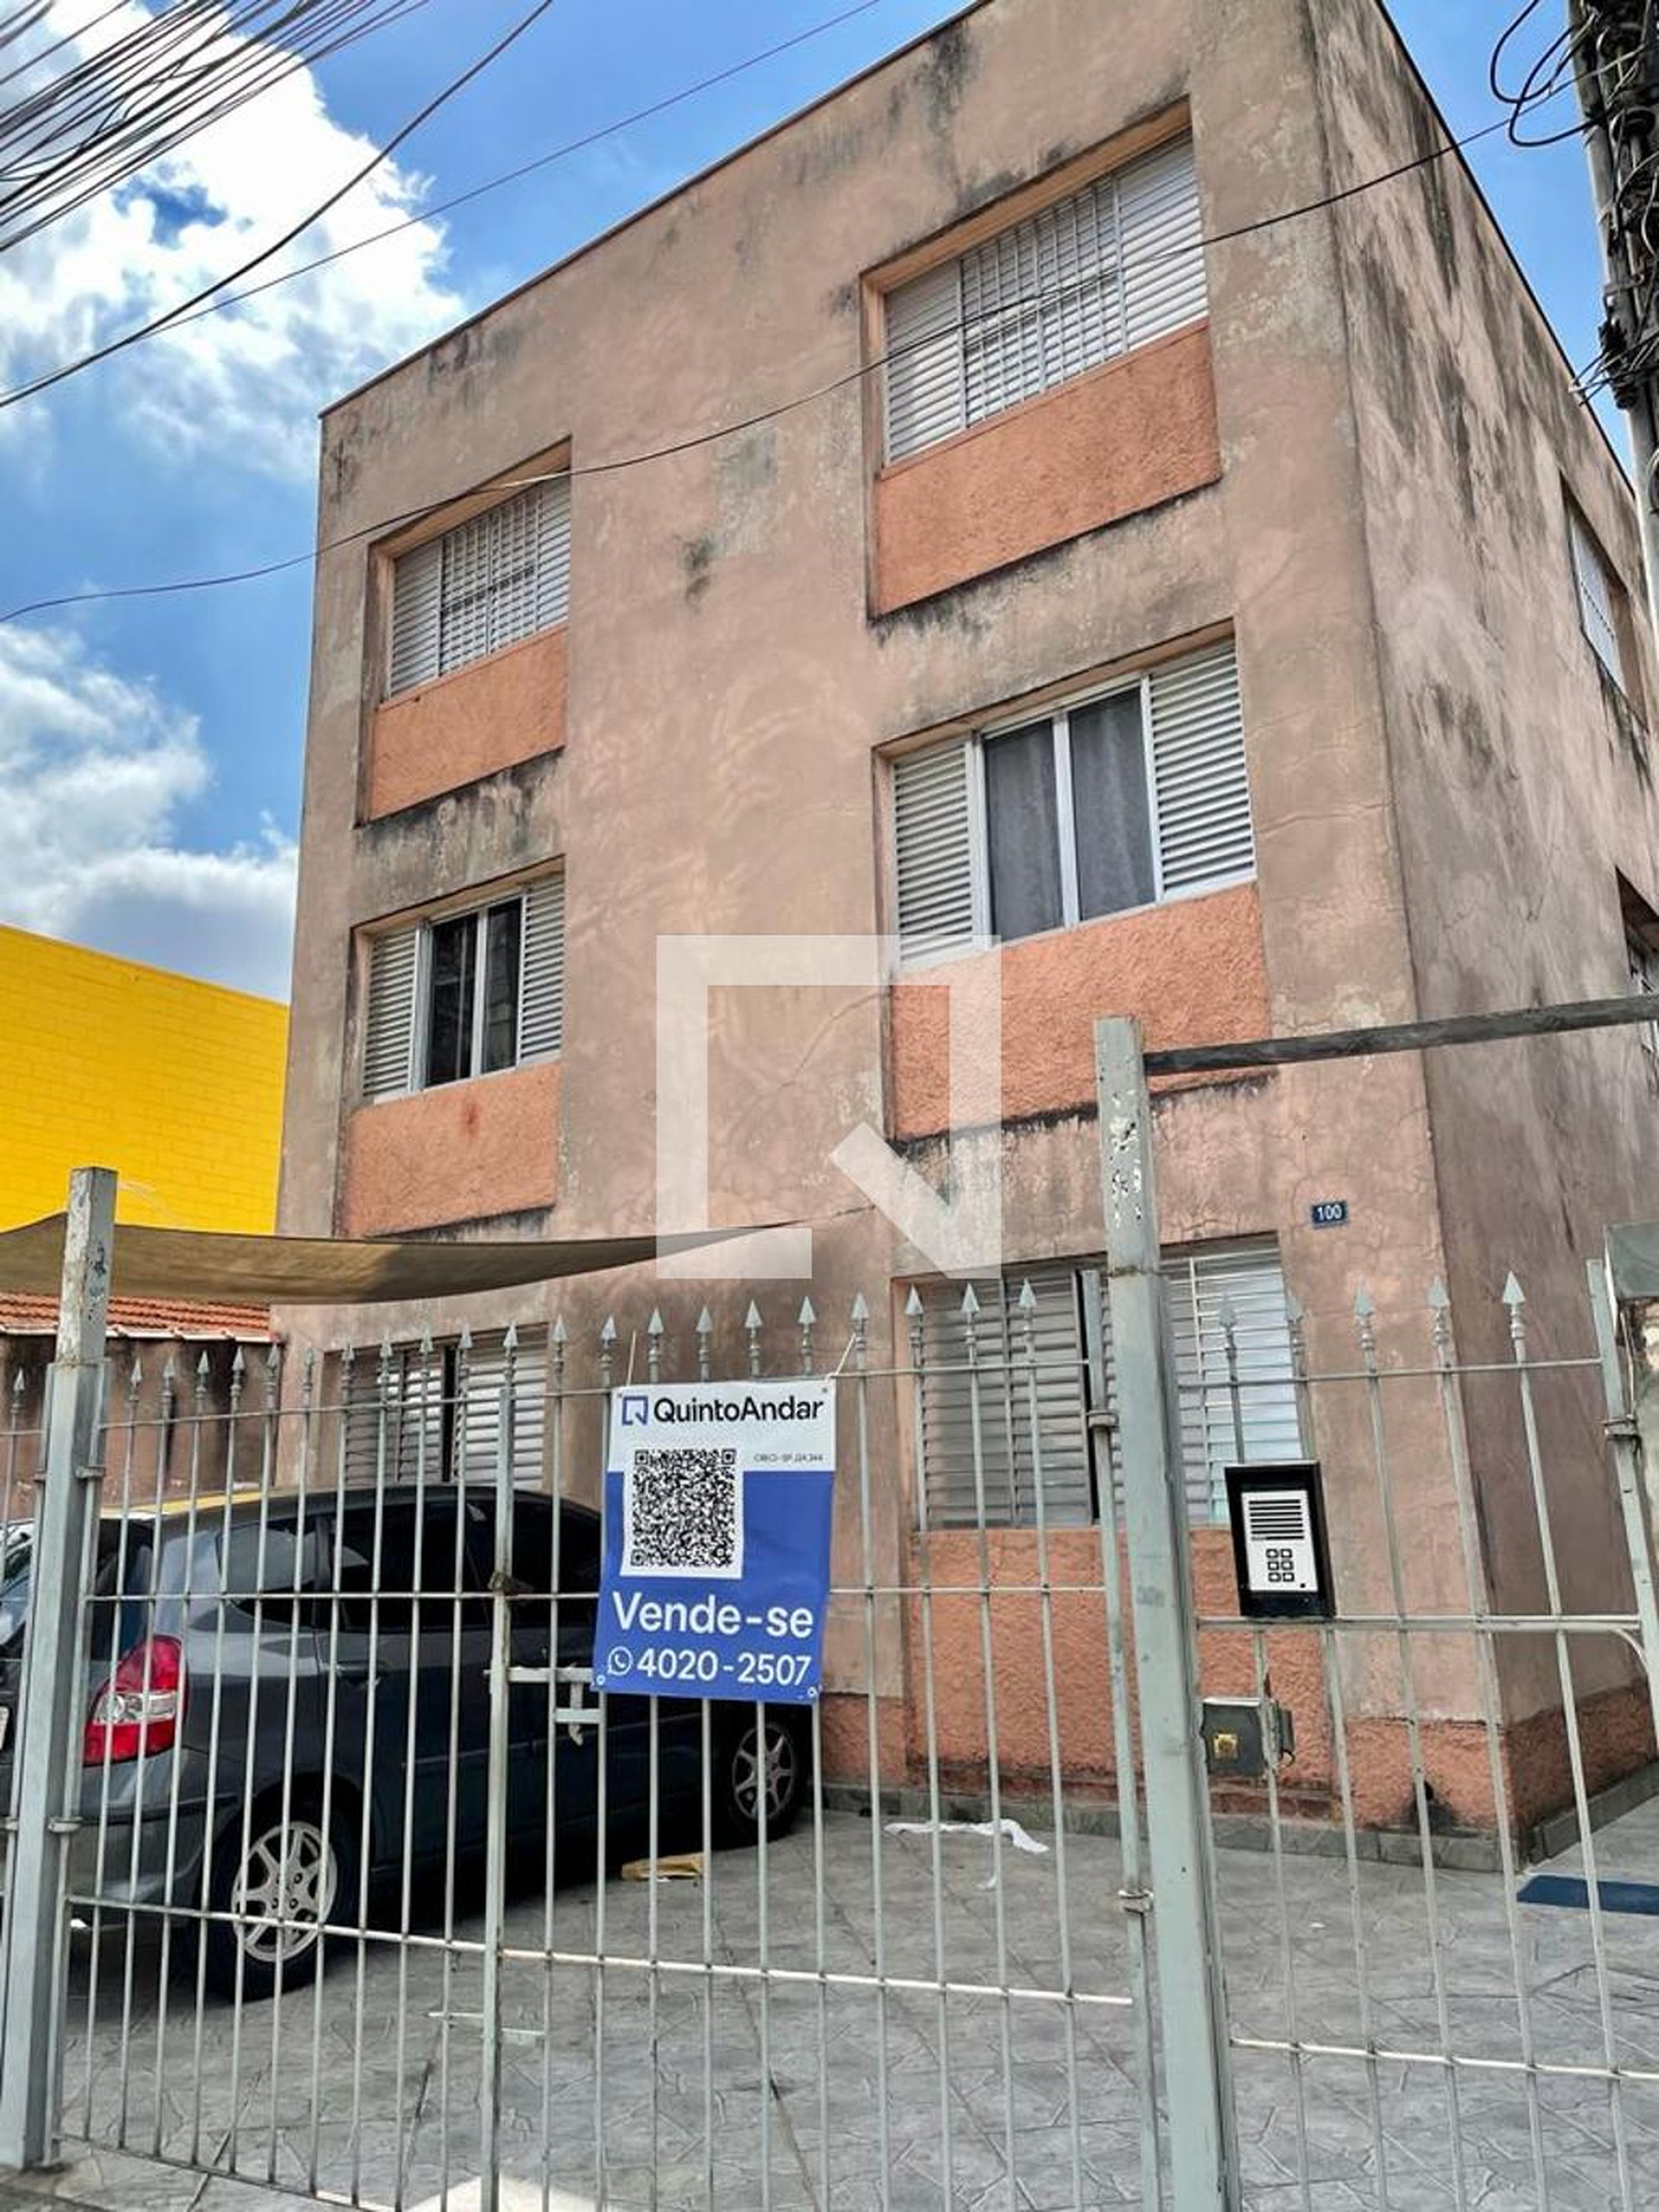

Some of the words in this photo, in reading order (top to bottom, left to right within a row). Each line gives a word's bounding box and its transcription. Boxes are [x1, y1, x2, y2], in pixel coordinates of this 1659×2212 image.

[1317, 1204, 1342, 1220] 100
[654, 1395, 824, 1423] QuintoAndar
[612, 1591, 814, 1638] Vende-se
